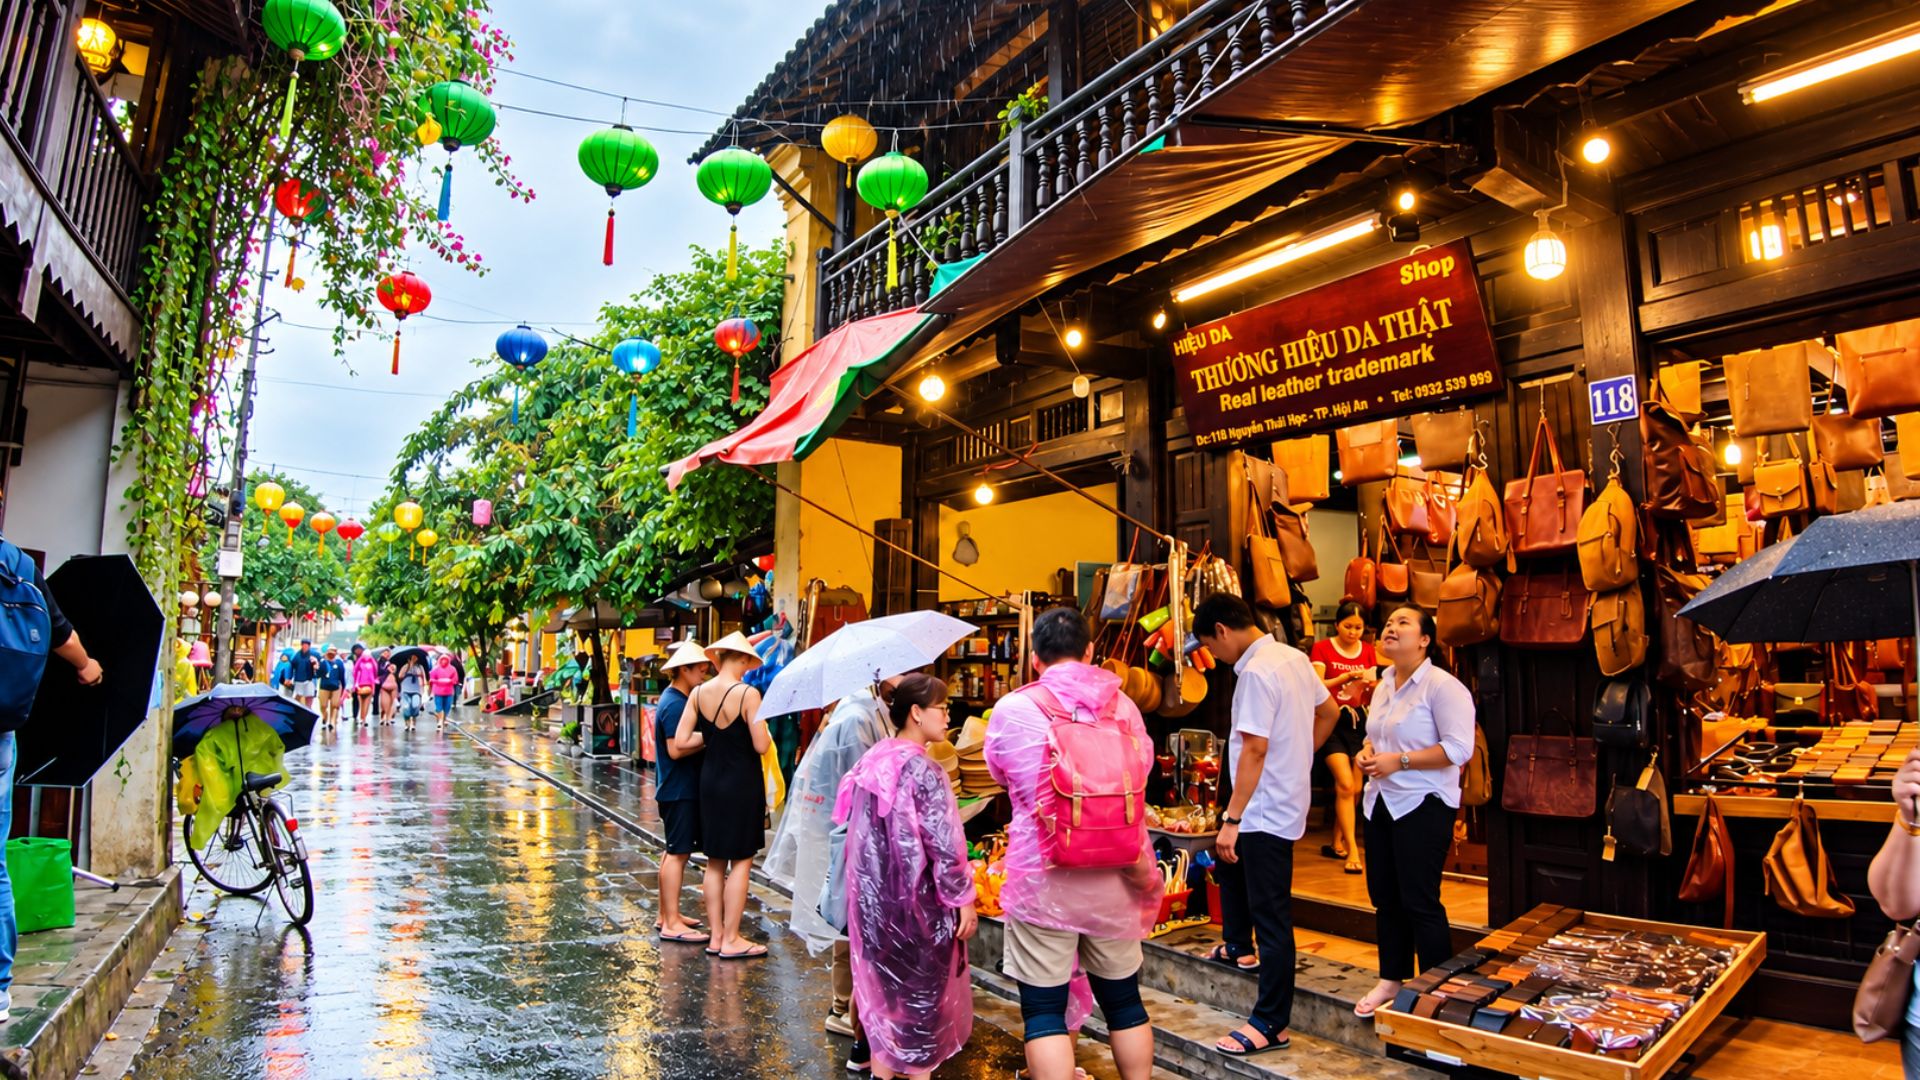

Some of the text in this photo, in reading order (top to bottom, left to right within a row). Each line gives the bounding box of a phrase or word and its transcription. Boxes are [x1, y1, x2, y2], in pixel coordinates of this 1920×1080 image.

[1400, 255, 1455, 285] Shop
[1173, 325, 1234, 356] HIỆU DA
[1190, 297, 1453, 393] THƯƠNG HIỆU DA THẬT
[1219, 342, 1435, 412] Real leather trademark
[1287, 413, 1308, 427] Học
[1353, 399, 1369, 413] An
[1391, 388, 1414, 403] Tel:
[1414, 381, 1445, 398] 0932
[1445, 375, 1467, 392] 539
[1592, 383, 1634, 417] 118
